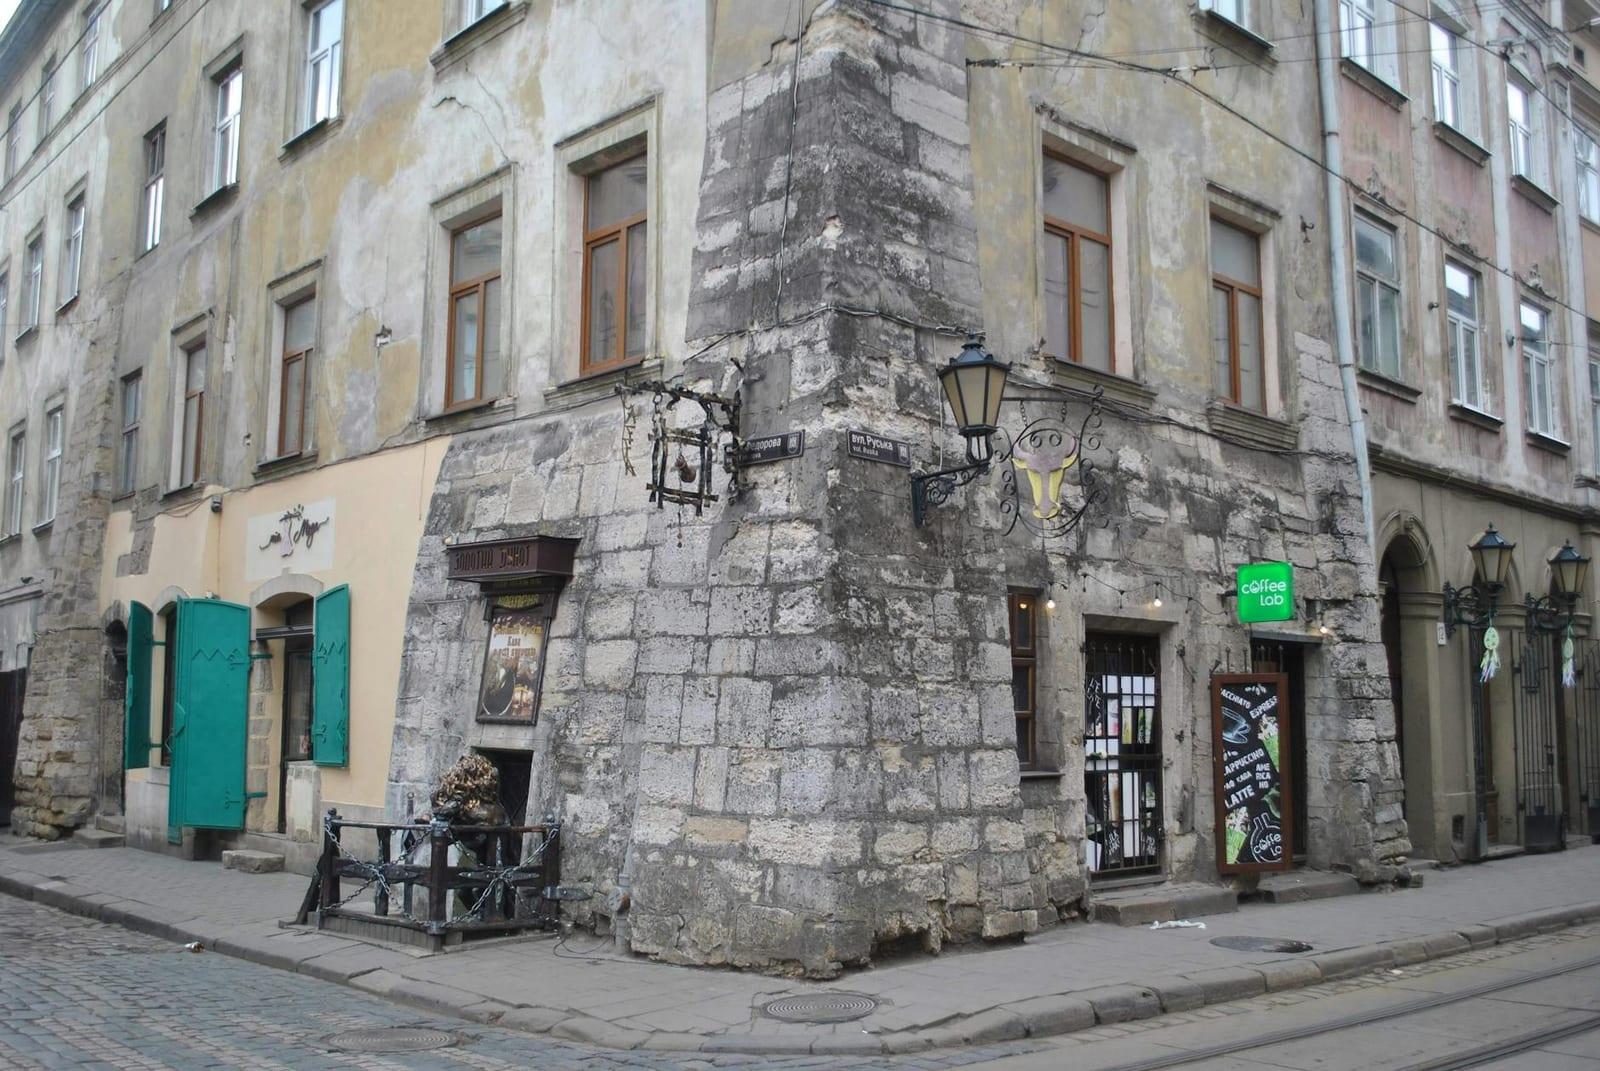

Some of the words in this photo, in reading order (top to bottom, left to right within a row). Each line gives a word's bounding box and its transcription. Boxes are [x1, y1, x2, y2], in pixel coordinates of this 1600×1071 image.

[866, 435, 893, 451] Руська
[1241, 579, 1287, 594] coffee
[1220, 688, 1251, 709] ACCHIATO
[1223, 748, 1264, 776] APPUCCINO
[1224, 785, 1255, 809] LATTE
